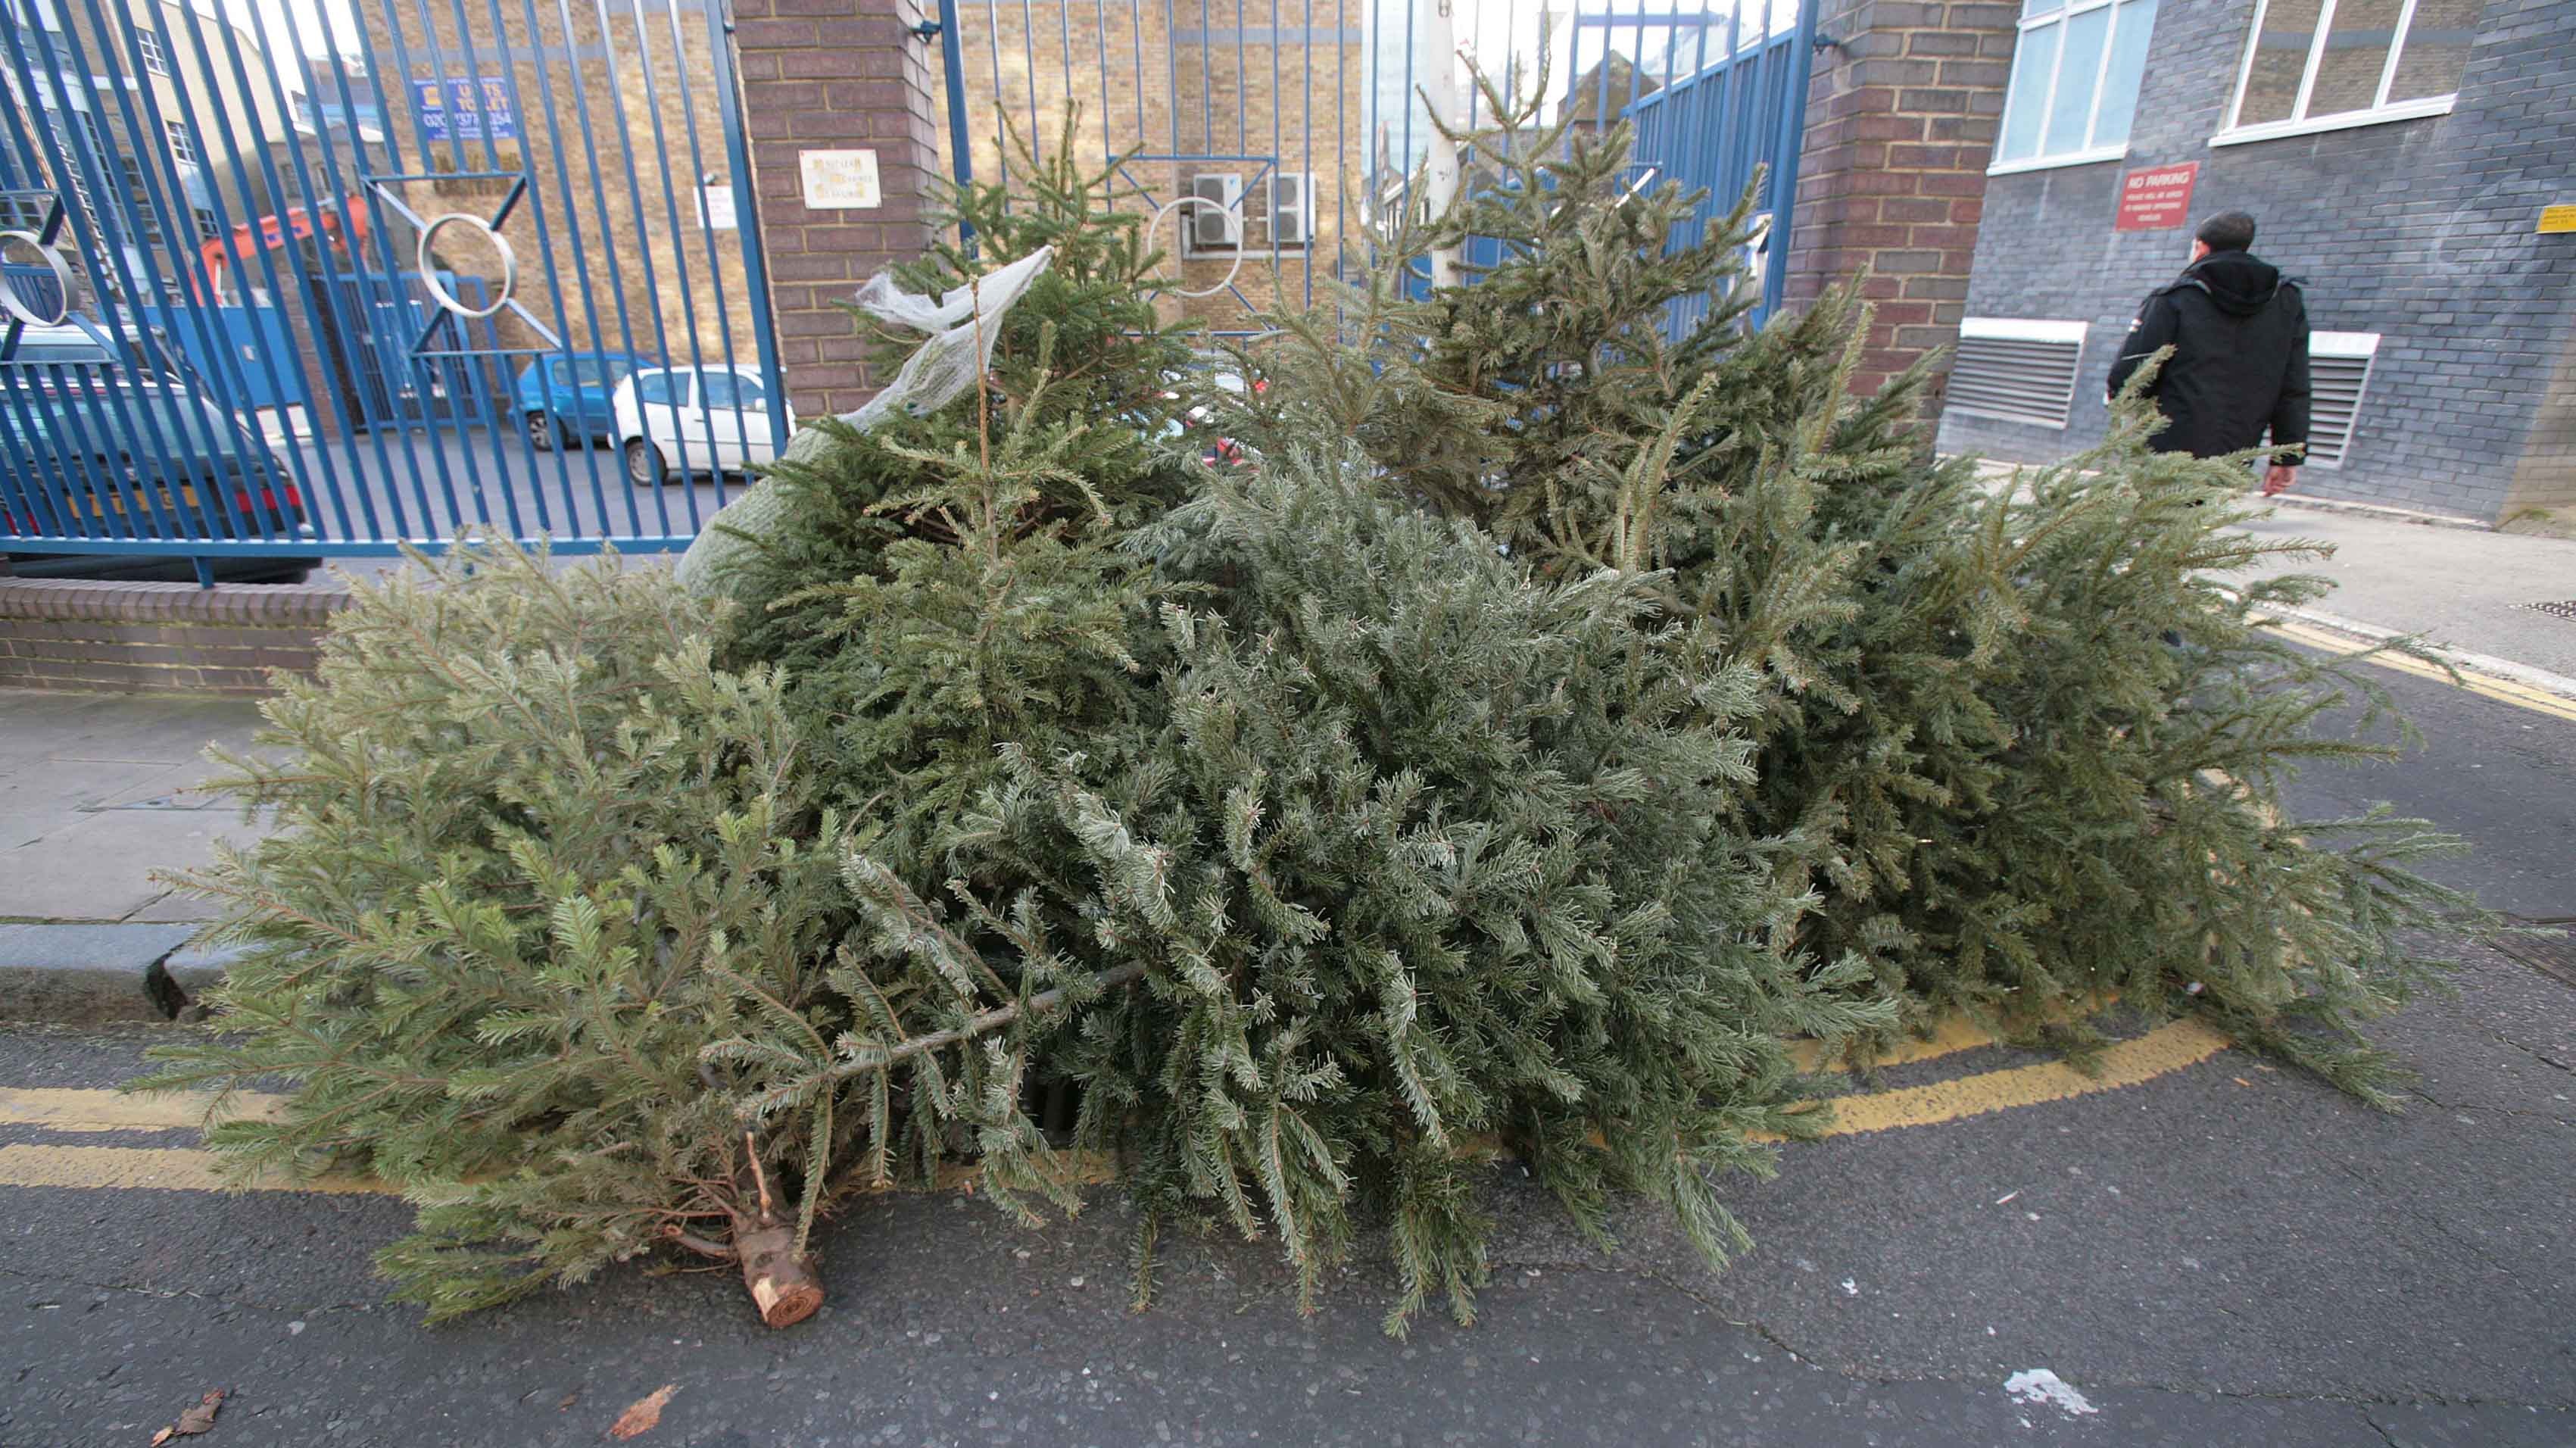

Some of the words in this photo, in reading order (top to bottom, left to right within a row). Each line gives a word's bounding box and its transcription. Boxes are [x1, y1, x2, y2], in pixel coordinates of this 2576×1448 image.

[457, 83, 502, 98] UTS
[2127, 177, 2144, 189] NO
[2145, 171, 2190, 187] PARKING
